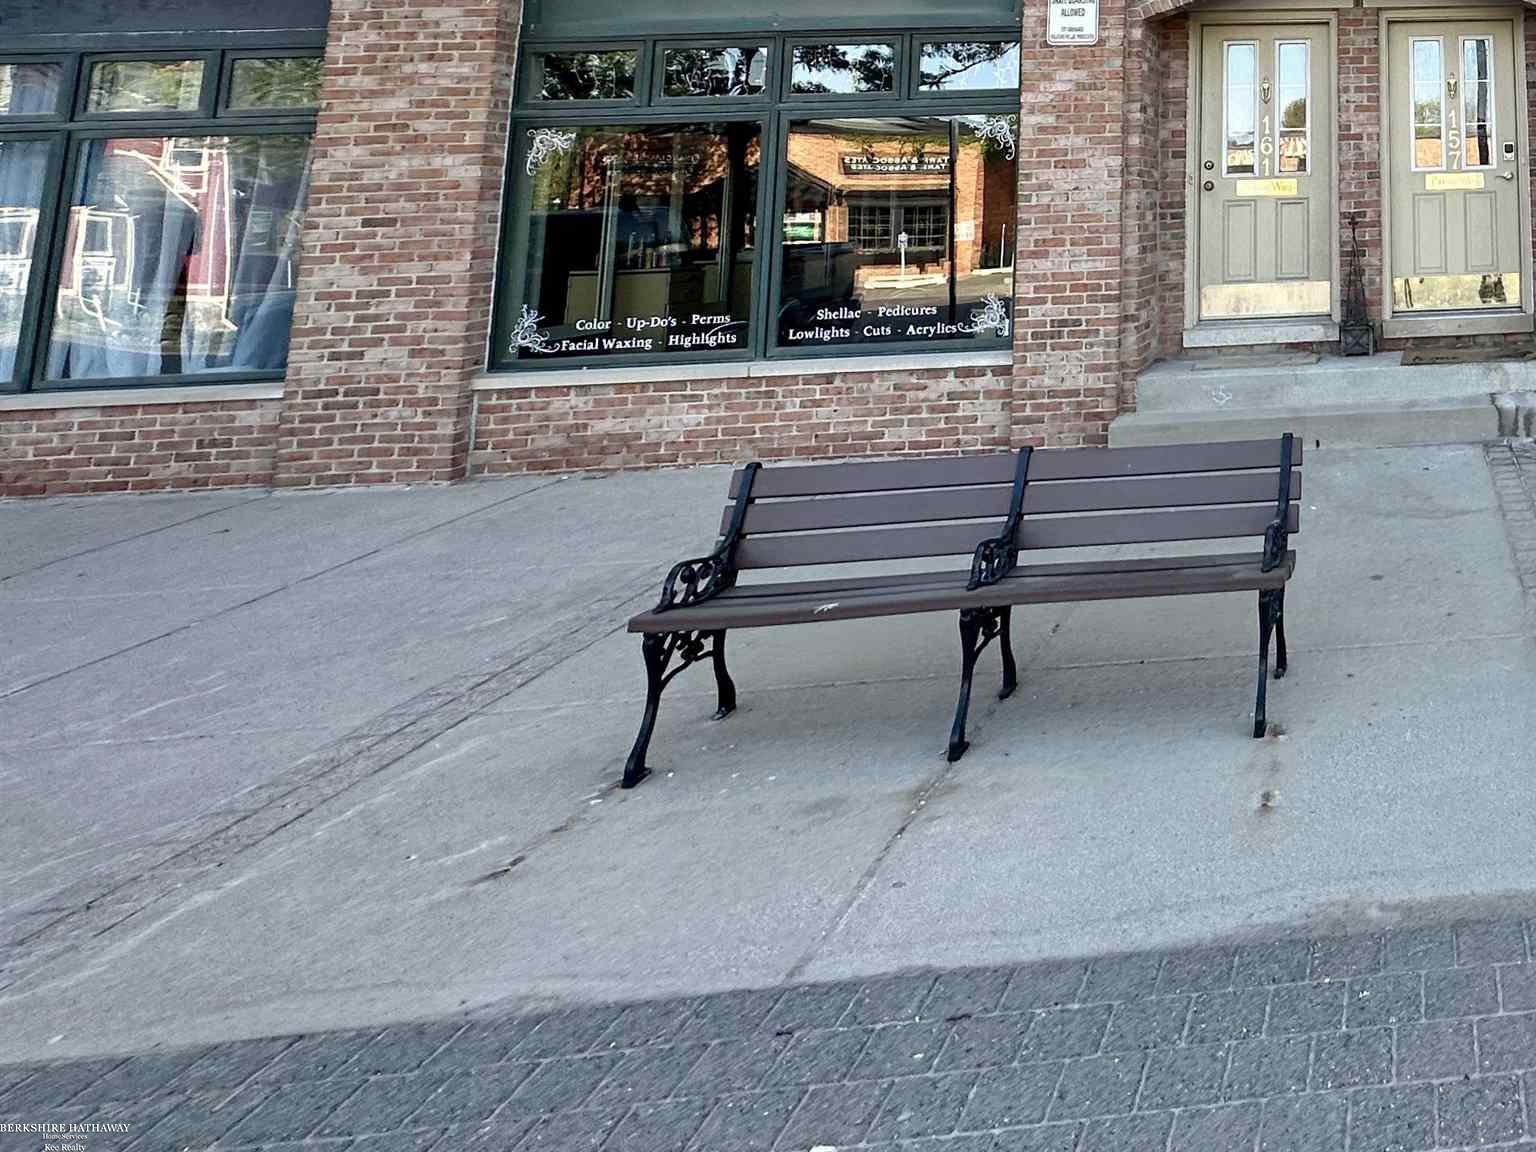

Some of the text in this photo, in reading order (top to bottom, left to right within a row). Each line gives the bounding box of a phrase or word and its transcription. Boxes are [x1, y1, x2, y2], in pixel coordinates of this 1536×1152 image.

[1260, 115, 1273, 177] 161
[1447, 108, 1462, 170] 157
[816, 307, 862, 320] Shellac
[877, 305, 938, 318] Pedicures
[575, 318, 612, 331] Color
[626, 316, 677, 331] Up-Do's
[691, 314, 731, 326] Perms
[788, 325, 850, 342] Lowlights
[863, 325, 892, 337] Cuts
[906, 322, 957, 338] Acrylics
[561, 338, 599, 351] Facial
[602, 337, 653, 350] Waxing
[668, 332, 737, 348] Highlights
